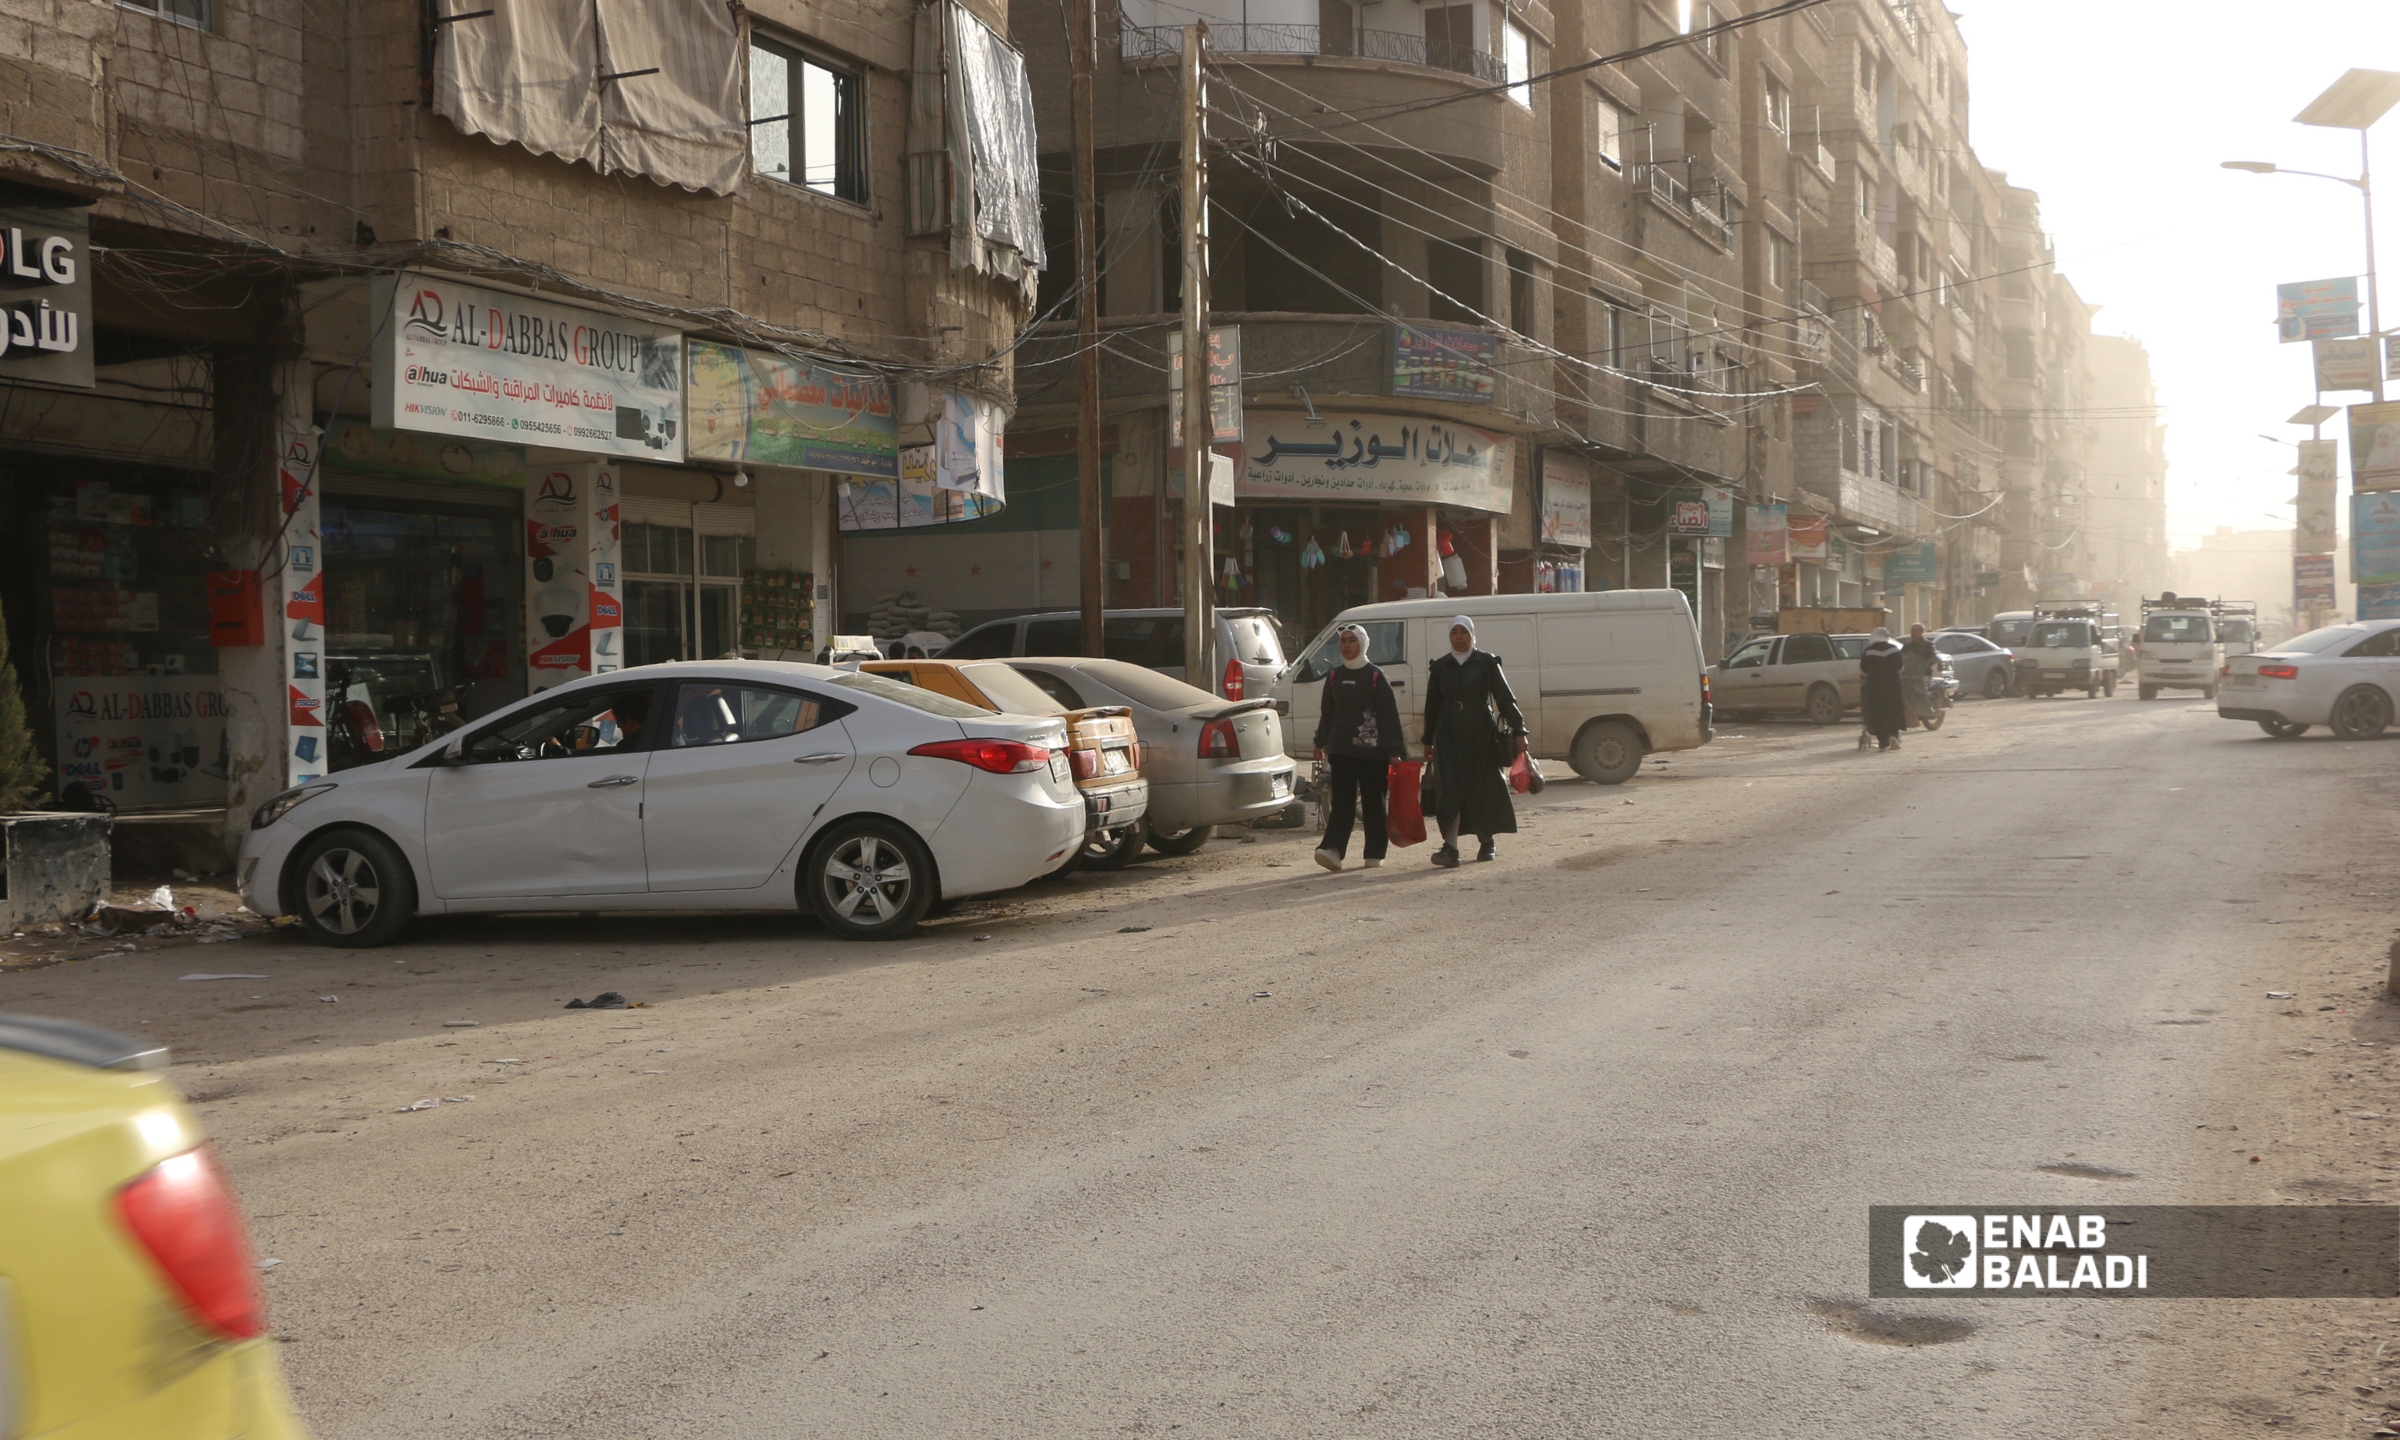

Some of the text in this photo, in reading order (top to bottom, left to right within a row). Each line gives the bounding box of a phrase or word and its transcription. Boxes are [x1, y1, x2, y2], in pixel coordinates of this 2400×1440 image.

[10, 227, 75, 285] LG
[451, 301, 640, 374] AL-DABBAS GROUP
[450, 369, 499, 399] والشبكات
[503, 377, 540, 404] المراقبة
[543, 384, 580, 408] كاميرات
[404, 402, 447, 417] HIKVISION
[458, 411, 506, 428] 011-6295866
[1251, 419, 1418, 470] الوزير
[1670, 501, 1709, 532] الضياء
[293, 591, 316, 602] DELL
[597, 605, 617, 616] DELL
[101, 691, 230, 720] AL-DABBAS GRO
[66, 762, 102, 777] DELL
